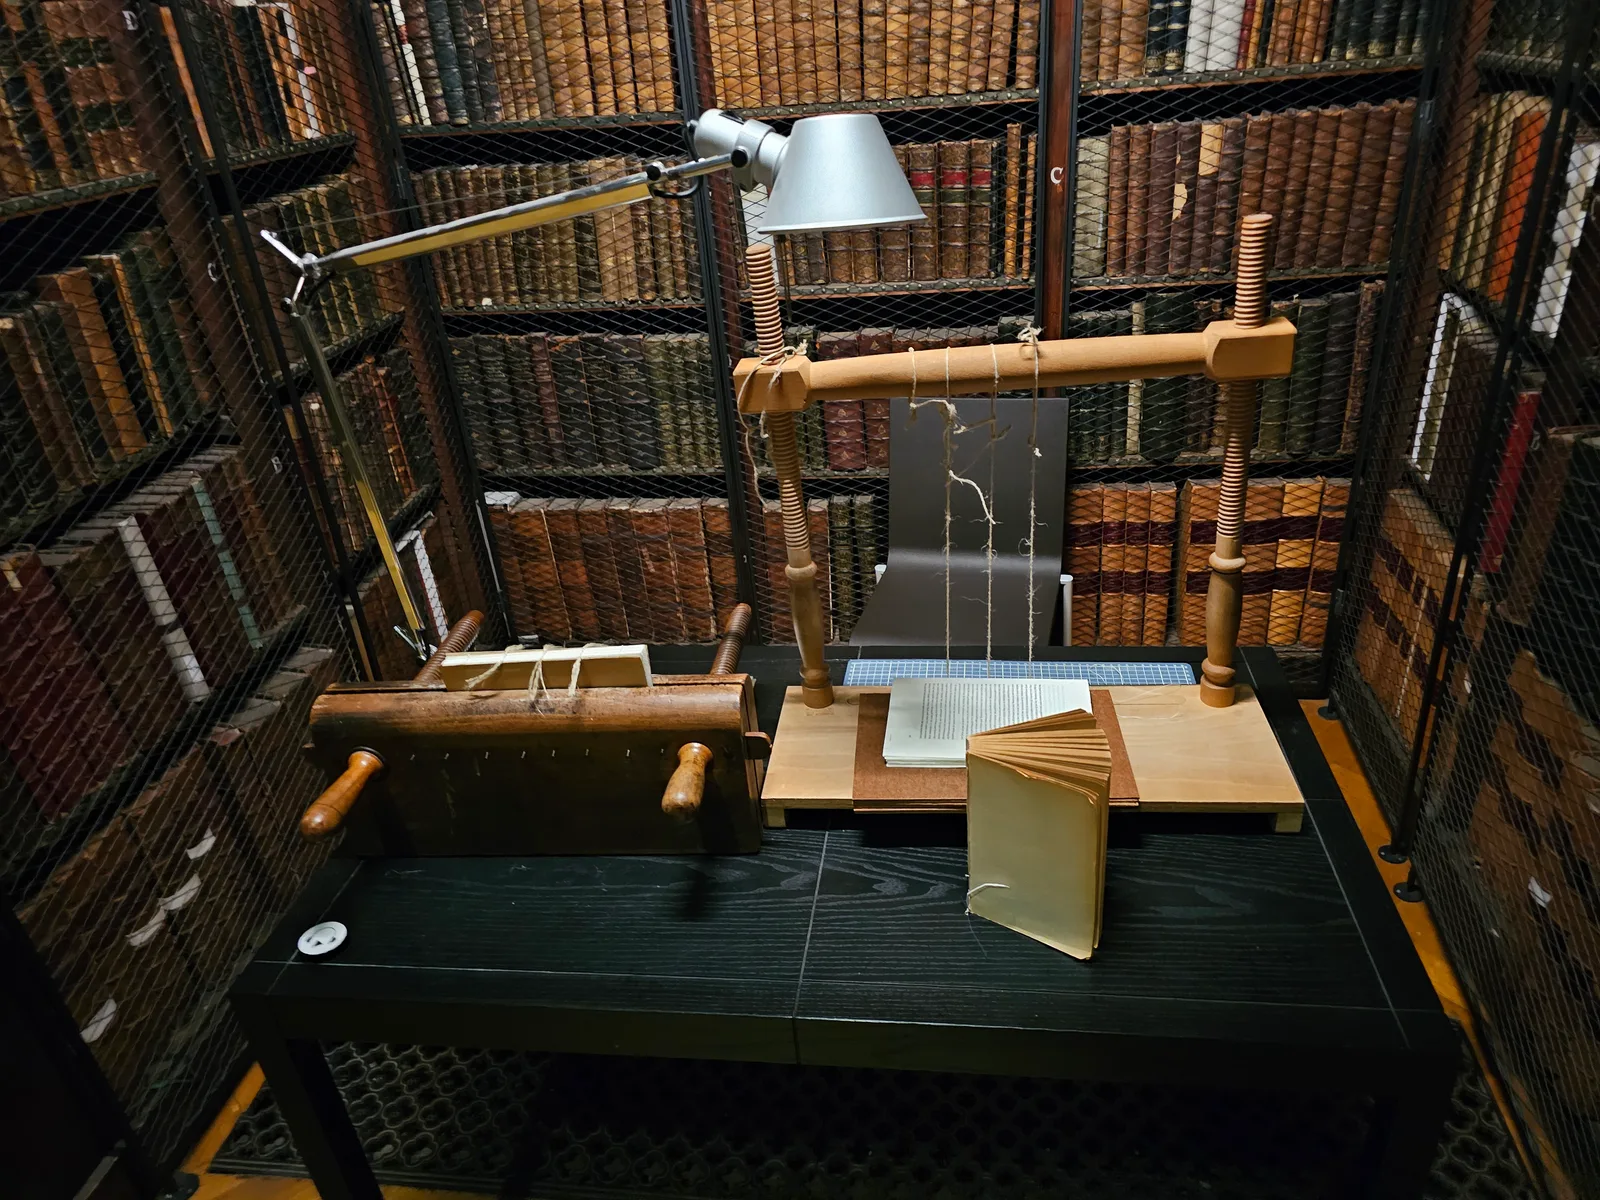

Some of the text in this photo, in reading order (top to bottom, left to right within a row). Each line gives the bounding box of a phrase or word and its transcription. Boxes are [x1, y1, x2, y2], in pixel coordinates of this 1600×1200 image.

[122, 10, 139, 30] D
[1050, 166, 1064, 185] C
[271, 456, 283, 474] B
